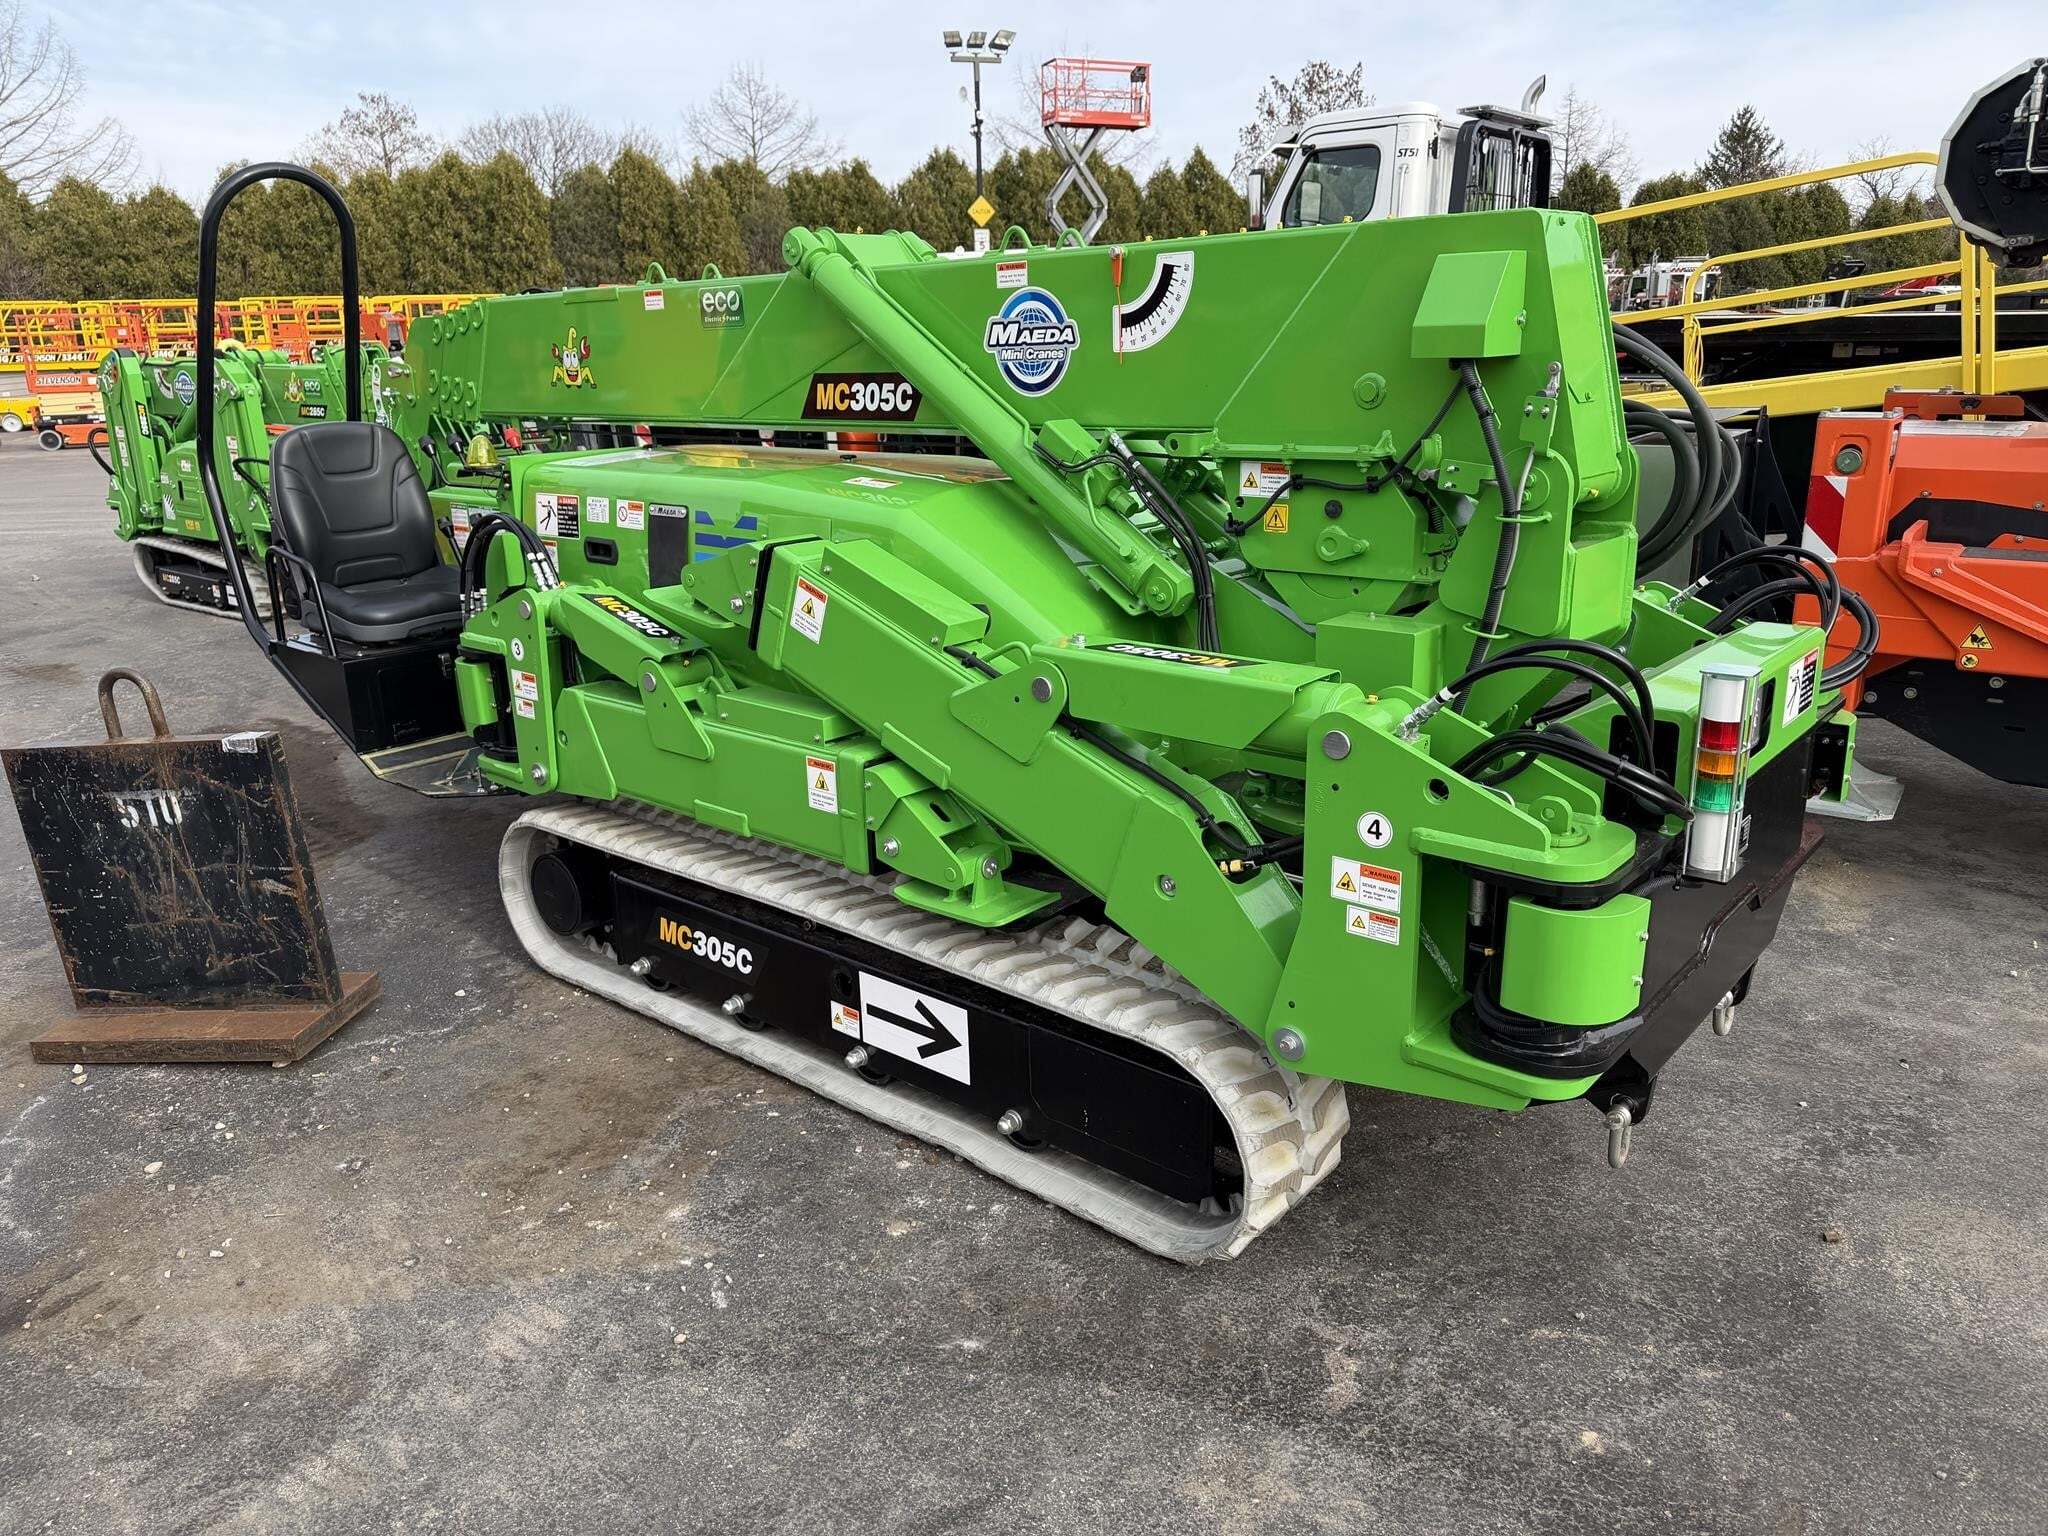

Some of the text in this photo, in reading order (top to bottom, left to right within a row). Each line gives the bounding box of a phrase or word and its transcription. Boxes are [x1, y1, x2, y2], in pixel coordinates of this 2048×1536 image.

[1397, 147, 1419, 158] ST51
[979, 241, 986, 250] 5
[703, 290, 740, 312] eco
[1001, 348, 1065, 361] Mini Cranes
[36, 375, 81, 385] STEVENSON
[304, 380, 320, 391] eco
[816, 382, 913, 412] MC305C
[593, 597, 669, 636] MC305C
[514, 643, 520, 656] 3
[1367, 819, 1383, 840] 4
[1369, 870, 1397, 881] WARNING
[660, 917, 753, 974] MC305C
